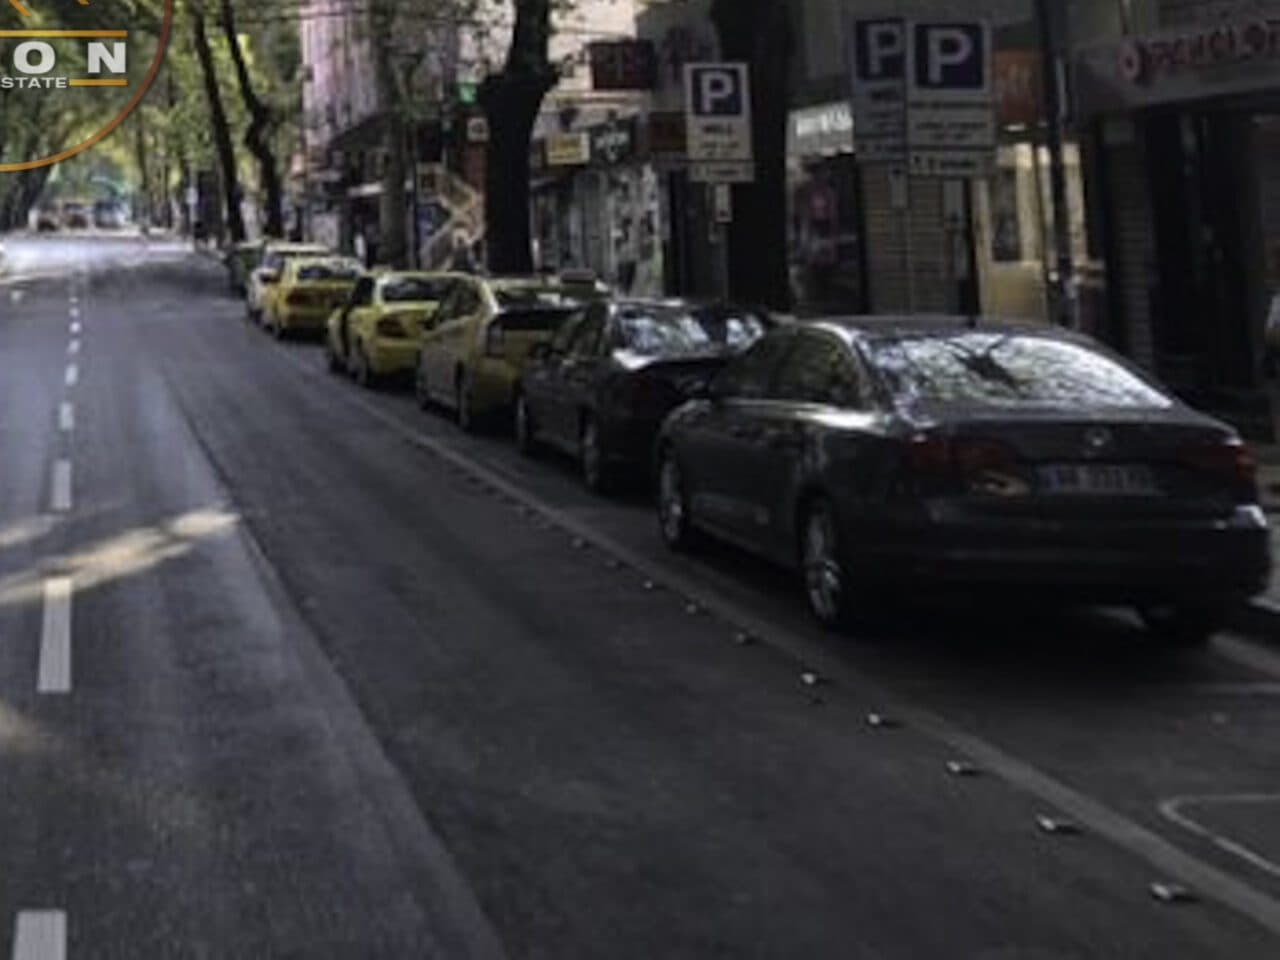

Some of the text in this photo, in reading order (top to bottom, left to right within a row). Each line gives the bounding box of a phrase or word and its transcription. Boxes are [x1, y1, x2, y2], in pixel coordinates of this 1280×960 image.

[869, 24, 905, 75] P
[927, 29, 974, 85] P
[701, 73, 735, 113] P
